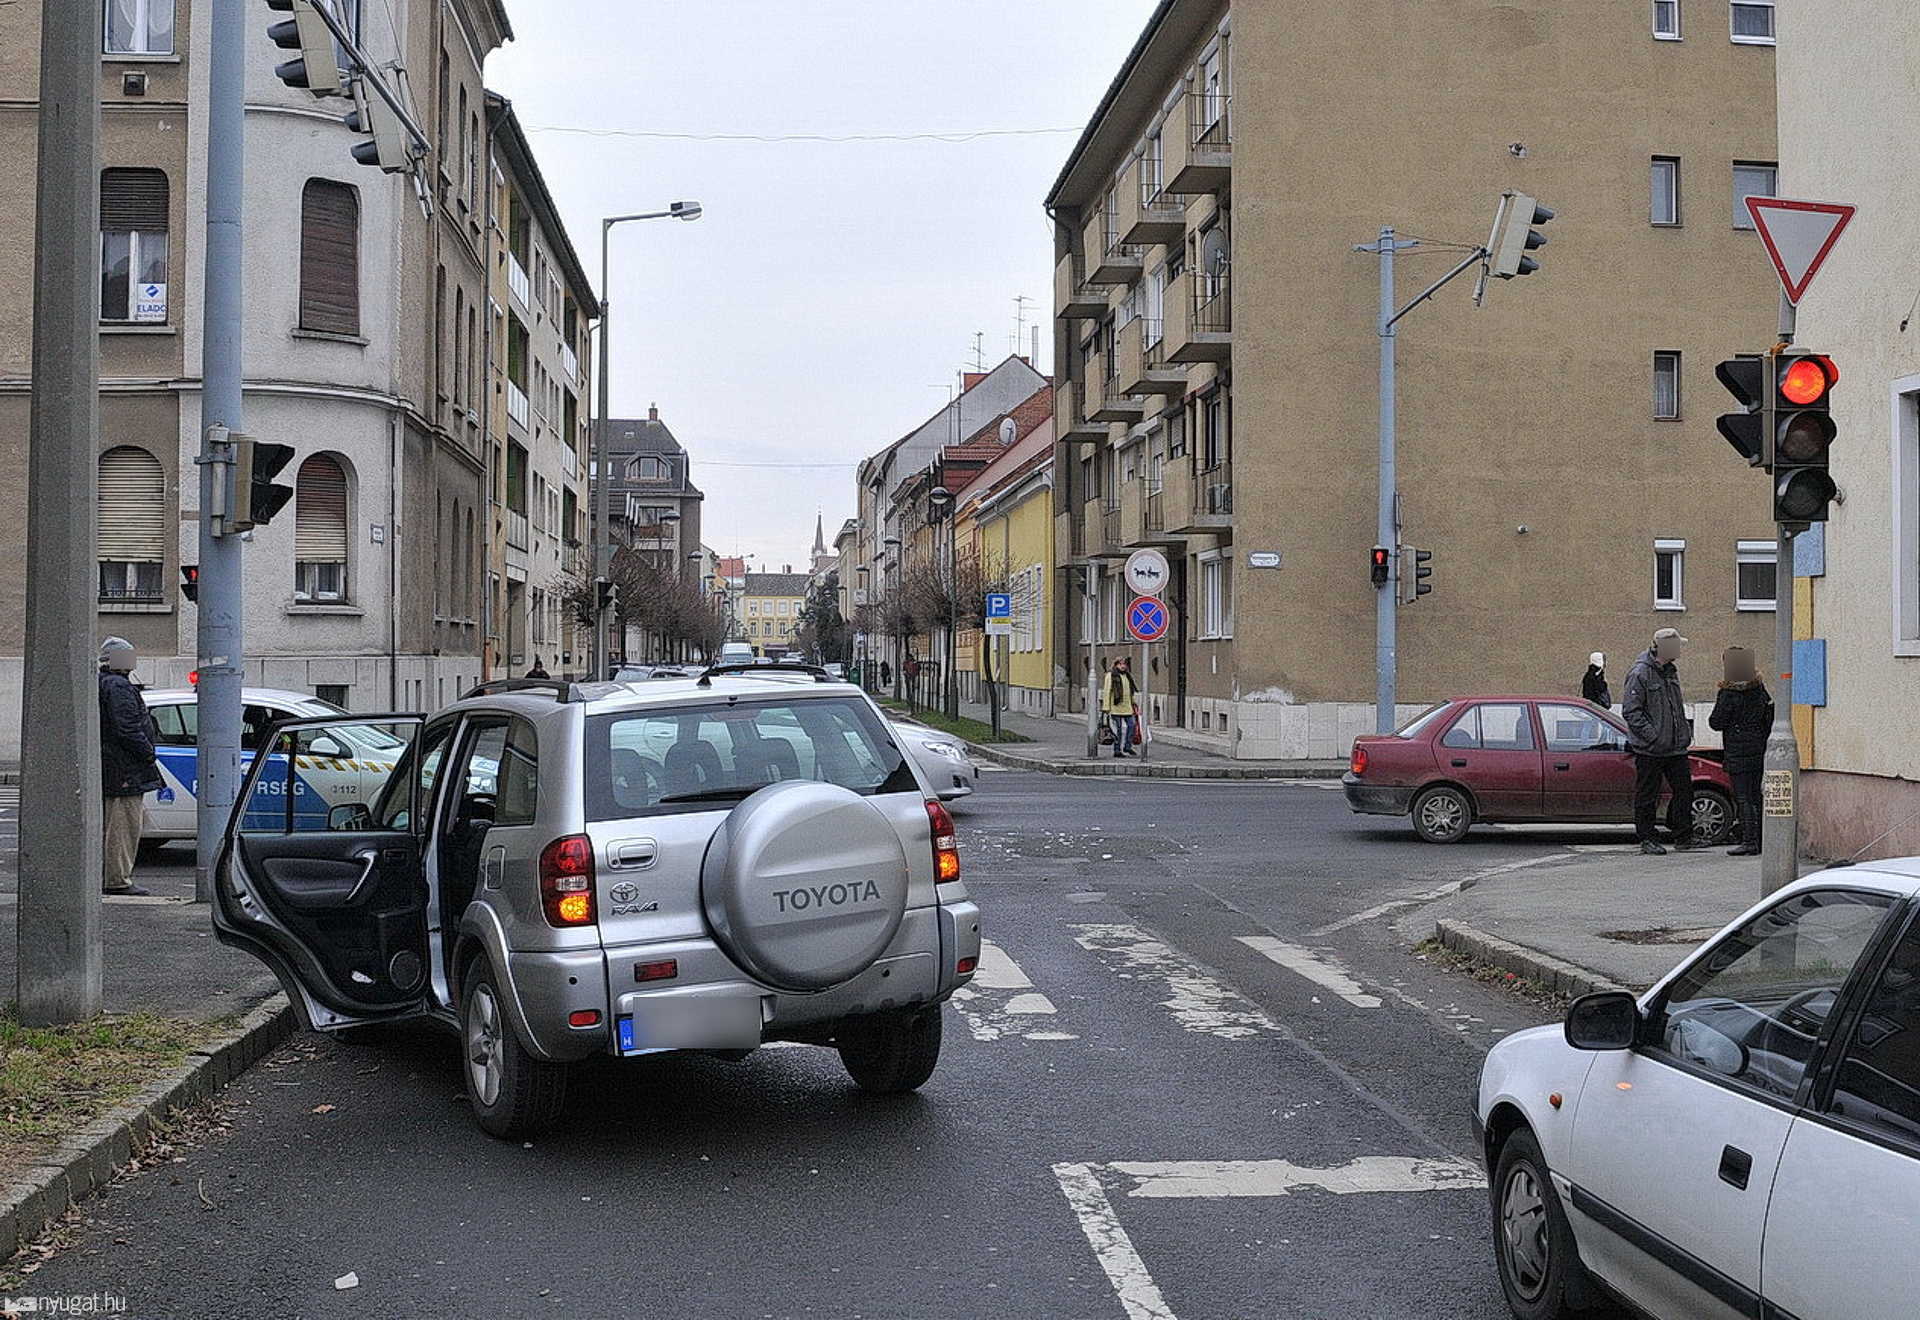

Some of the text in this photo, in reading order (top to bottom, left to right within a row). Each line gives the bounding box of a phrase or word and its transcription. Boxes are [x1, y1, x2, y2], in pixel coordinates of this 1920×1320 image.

[992, 597, 1006, 615] P
[772, 879, 881, 913] TOYOTA
[611, 900, 659, 916] RAV4
[623, 1035, 632, 1047] H
